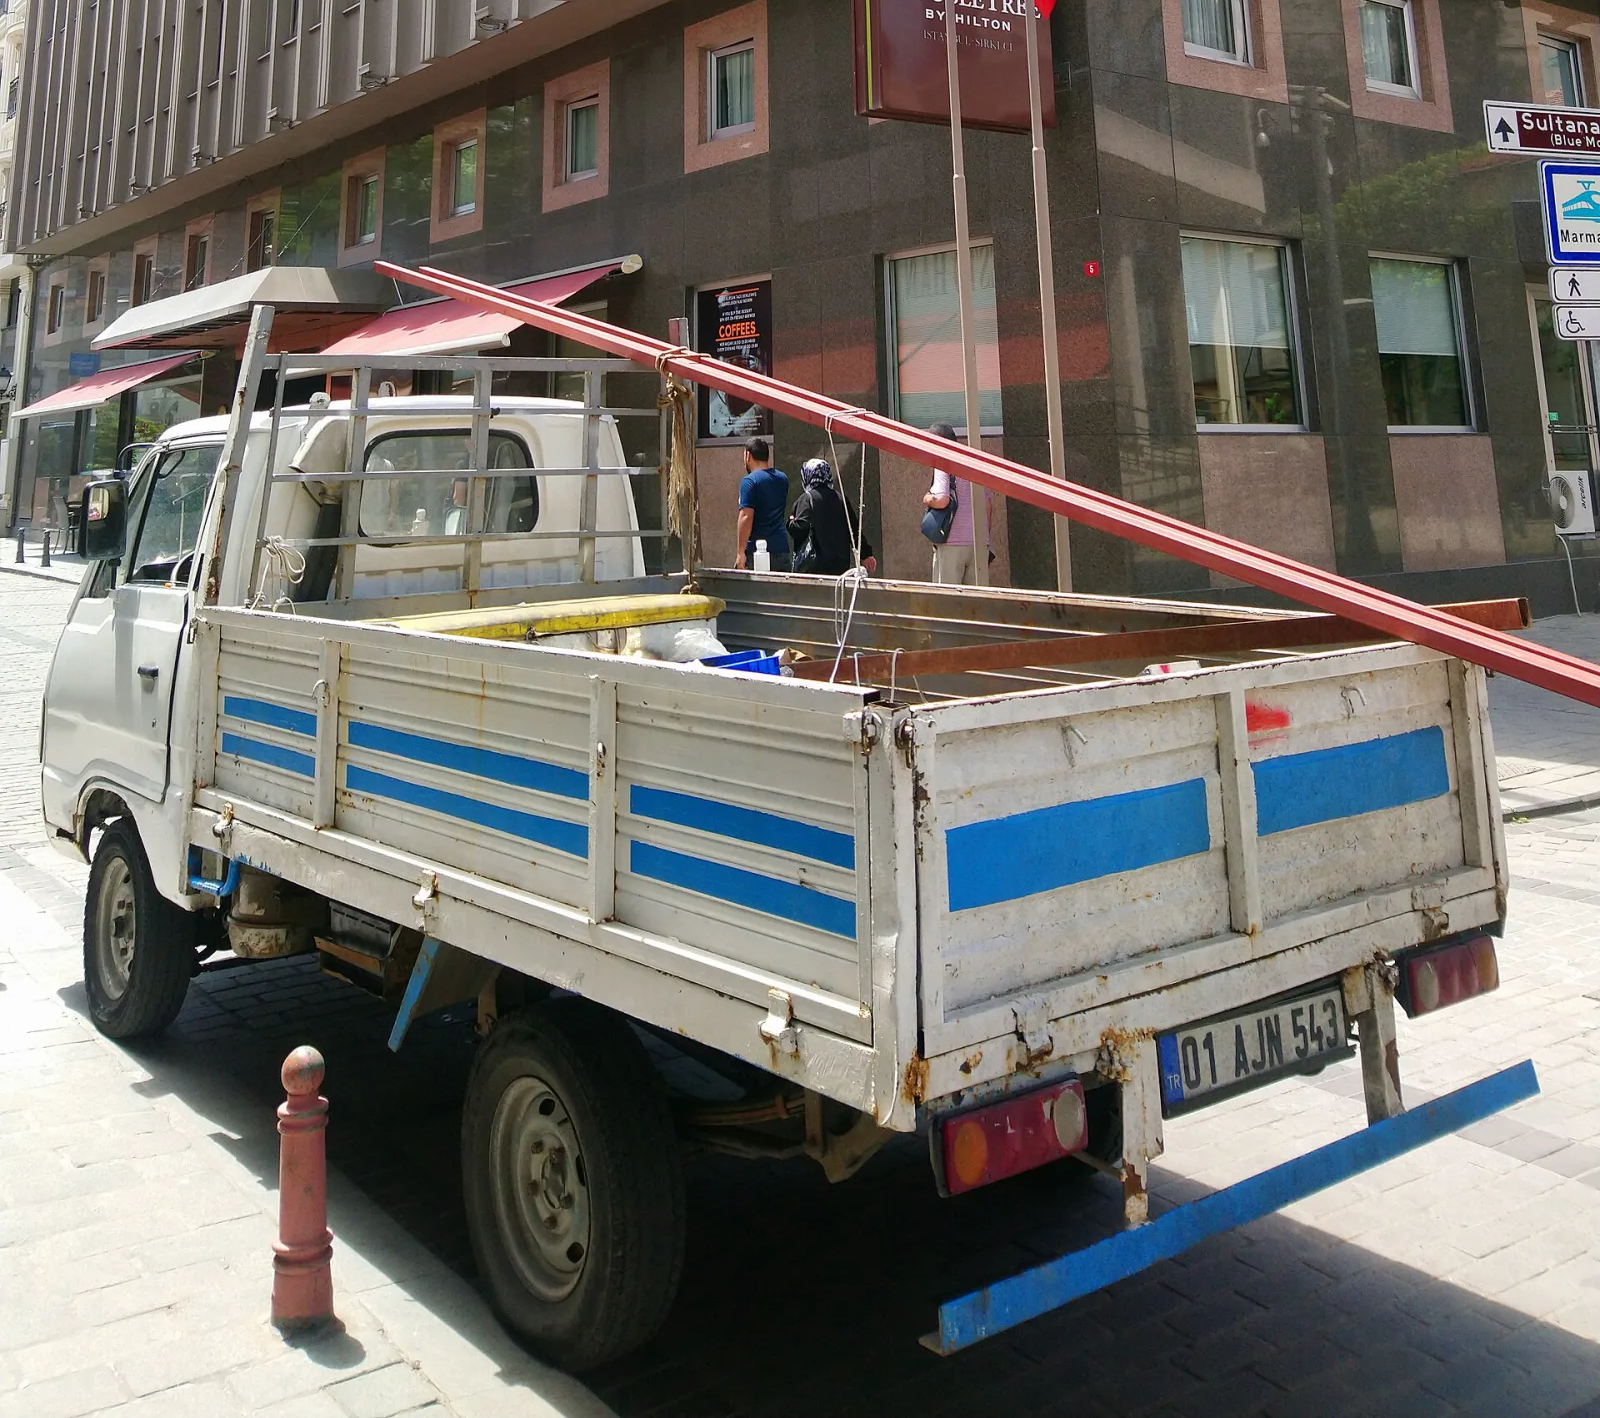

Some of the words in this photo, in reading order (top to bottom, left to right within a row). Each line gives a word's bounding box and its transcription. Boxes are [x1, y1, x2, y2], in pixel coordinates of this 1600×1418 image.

[925, 8, 945, 21] BY
[955, 13, 1012, 32] HILTON
[1521, 112, 1600, 135] Sultana
[1550, 133, 1582, 147] (Blue
[1089, 264, 1095, 274] 5
[719, 320, 756, 338] COFFEES
[1181, 1031, 1218, 1090] 01
[1234, 1013, 1284, 1078] AJN
[1291, 998, 1339, 1060] 543
[1167, 1073, 1182, 1091] TR
